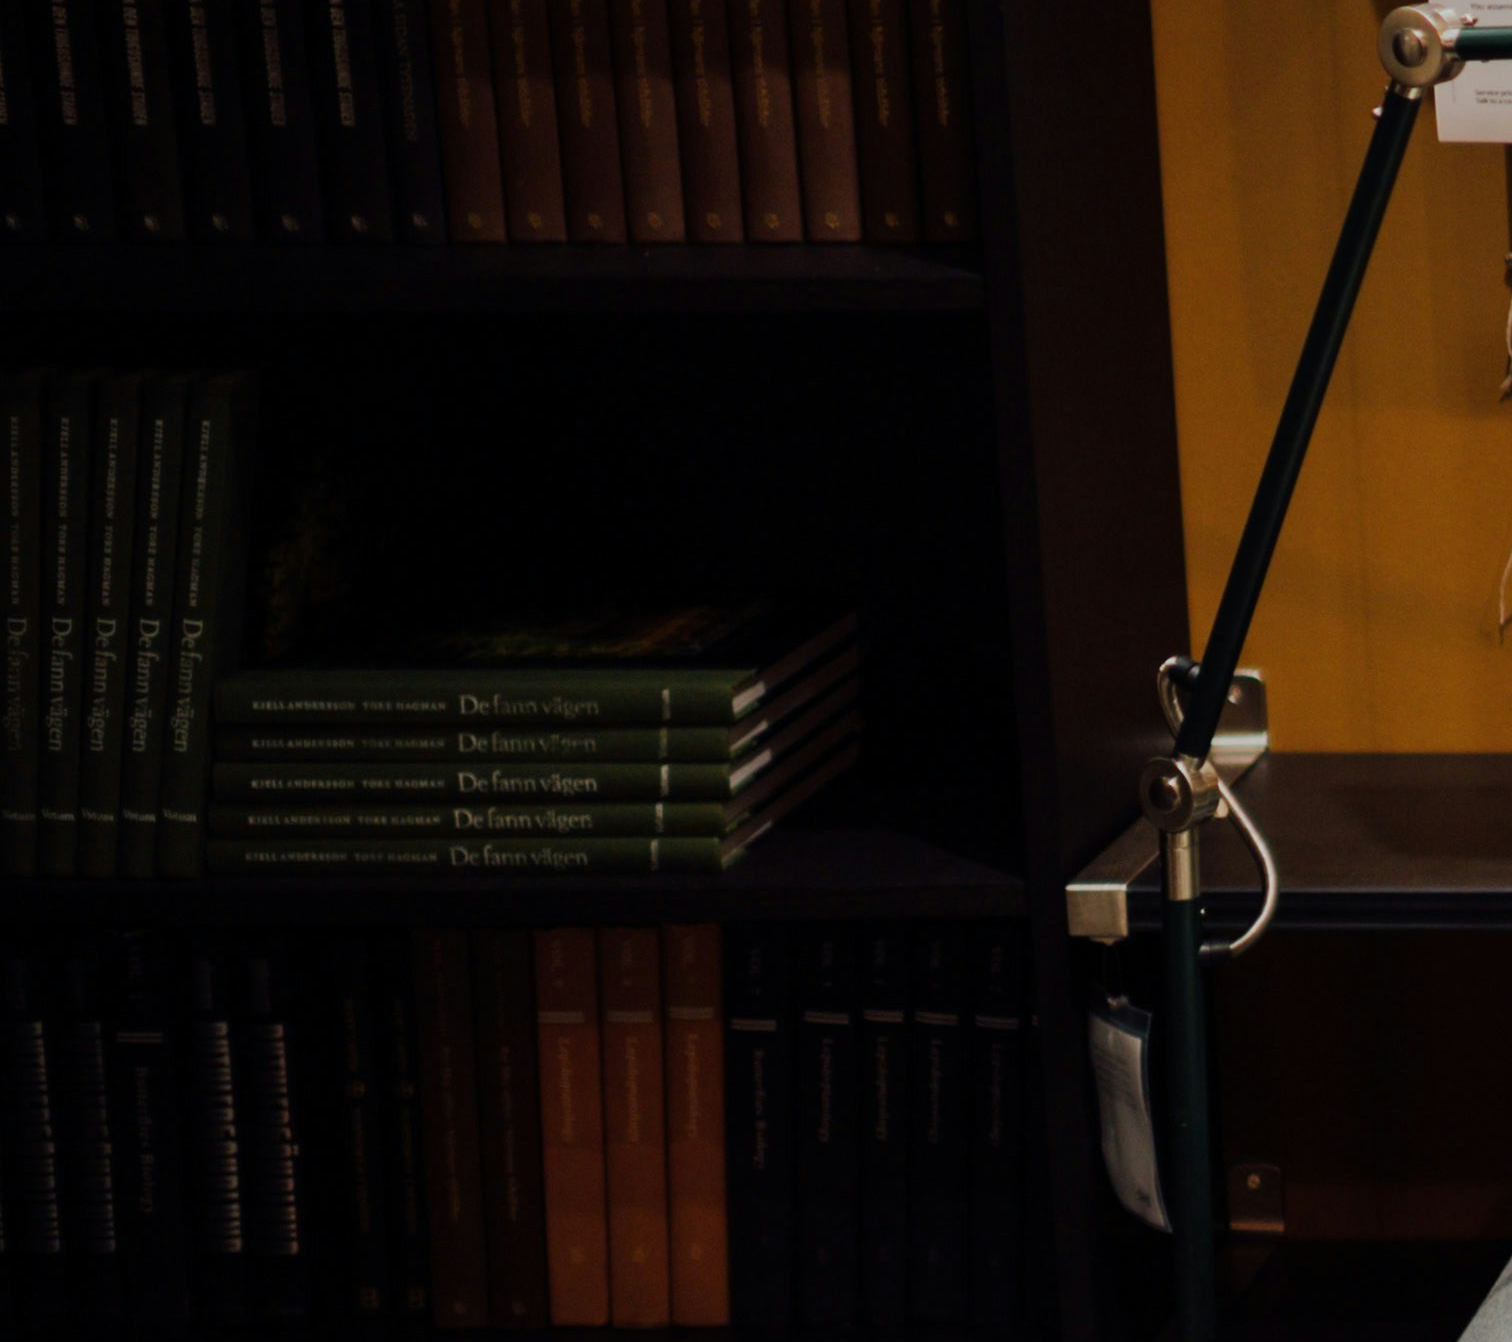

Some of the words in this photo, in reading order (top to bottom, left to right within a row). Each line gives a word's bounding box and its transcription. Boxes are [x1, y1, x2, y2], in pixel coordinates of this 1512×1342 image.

[457, 772, 488, 793] De
[492, 771, 537, 792] fann
[540, 773, 598, 795] vägen
